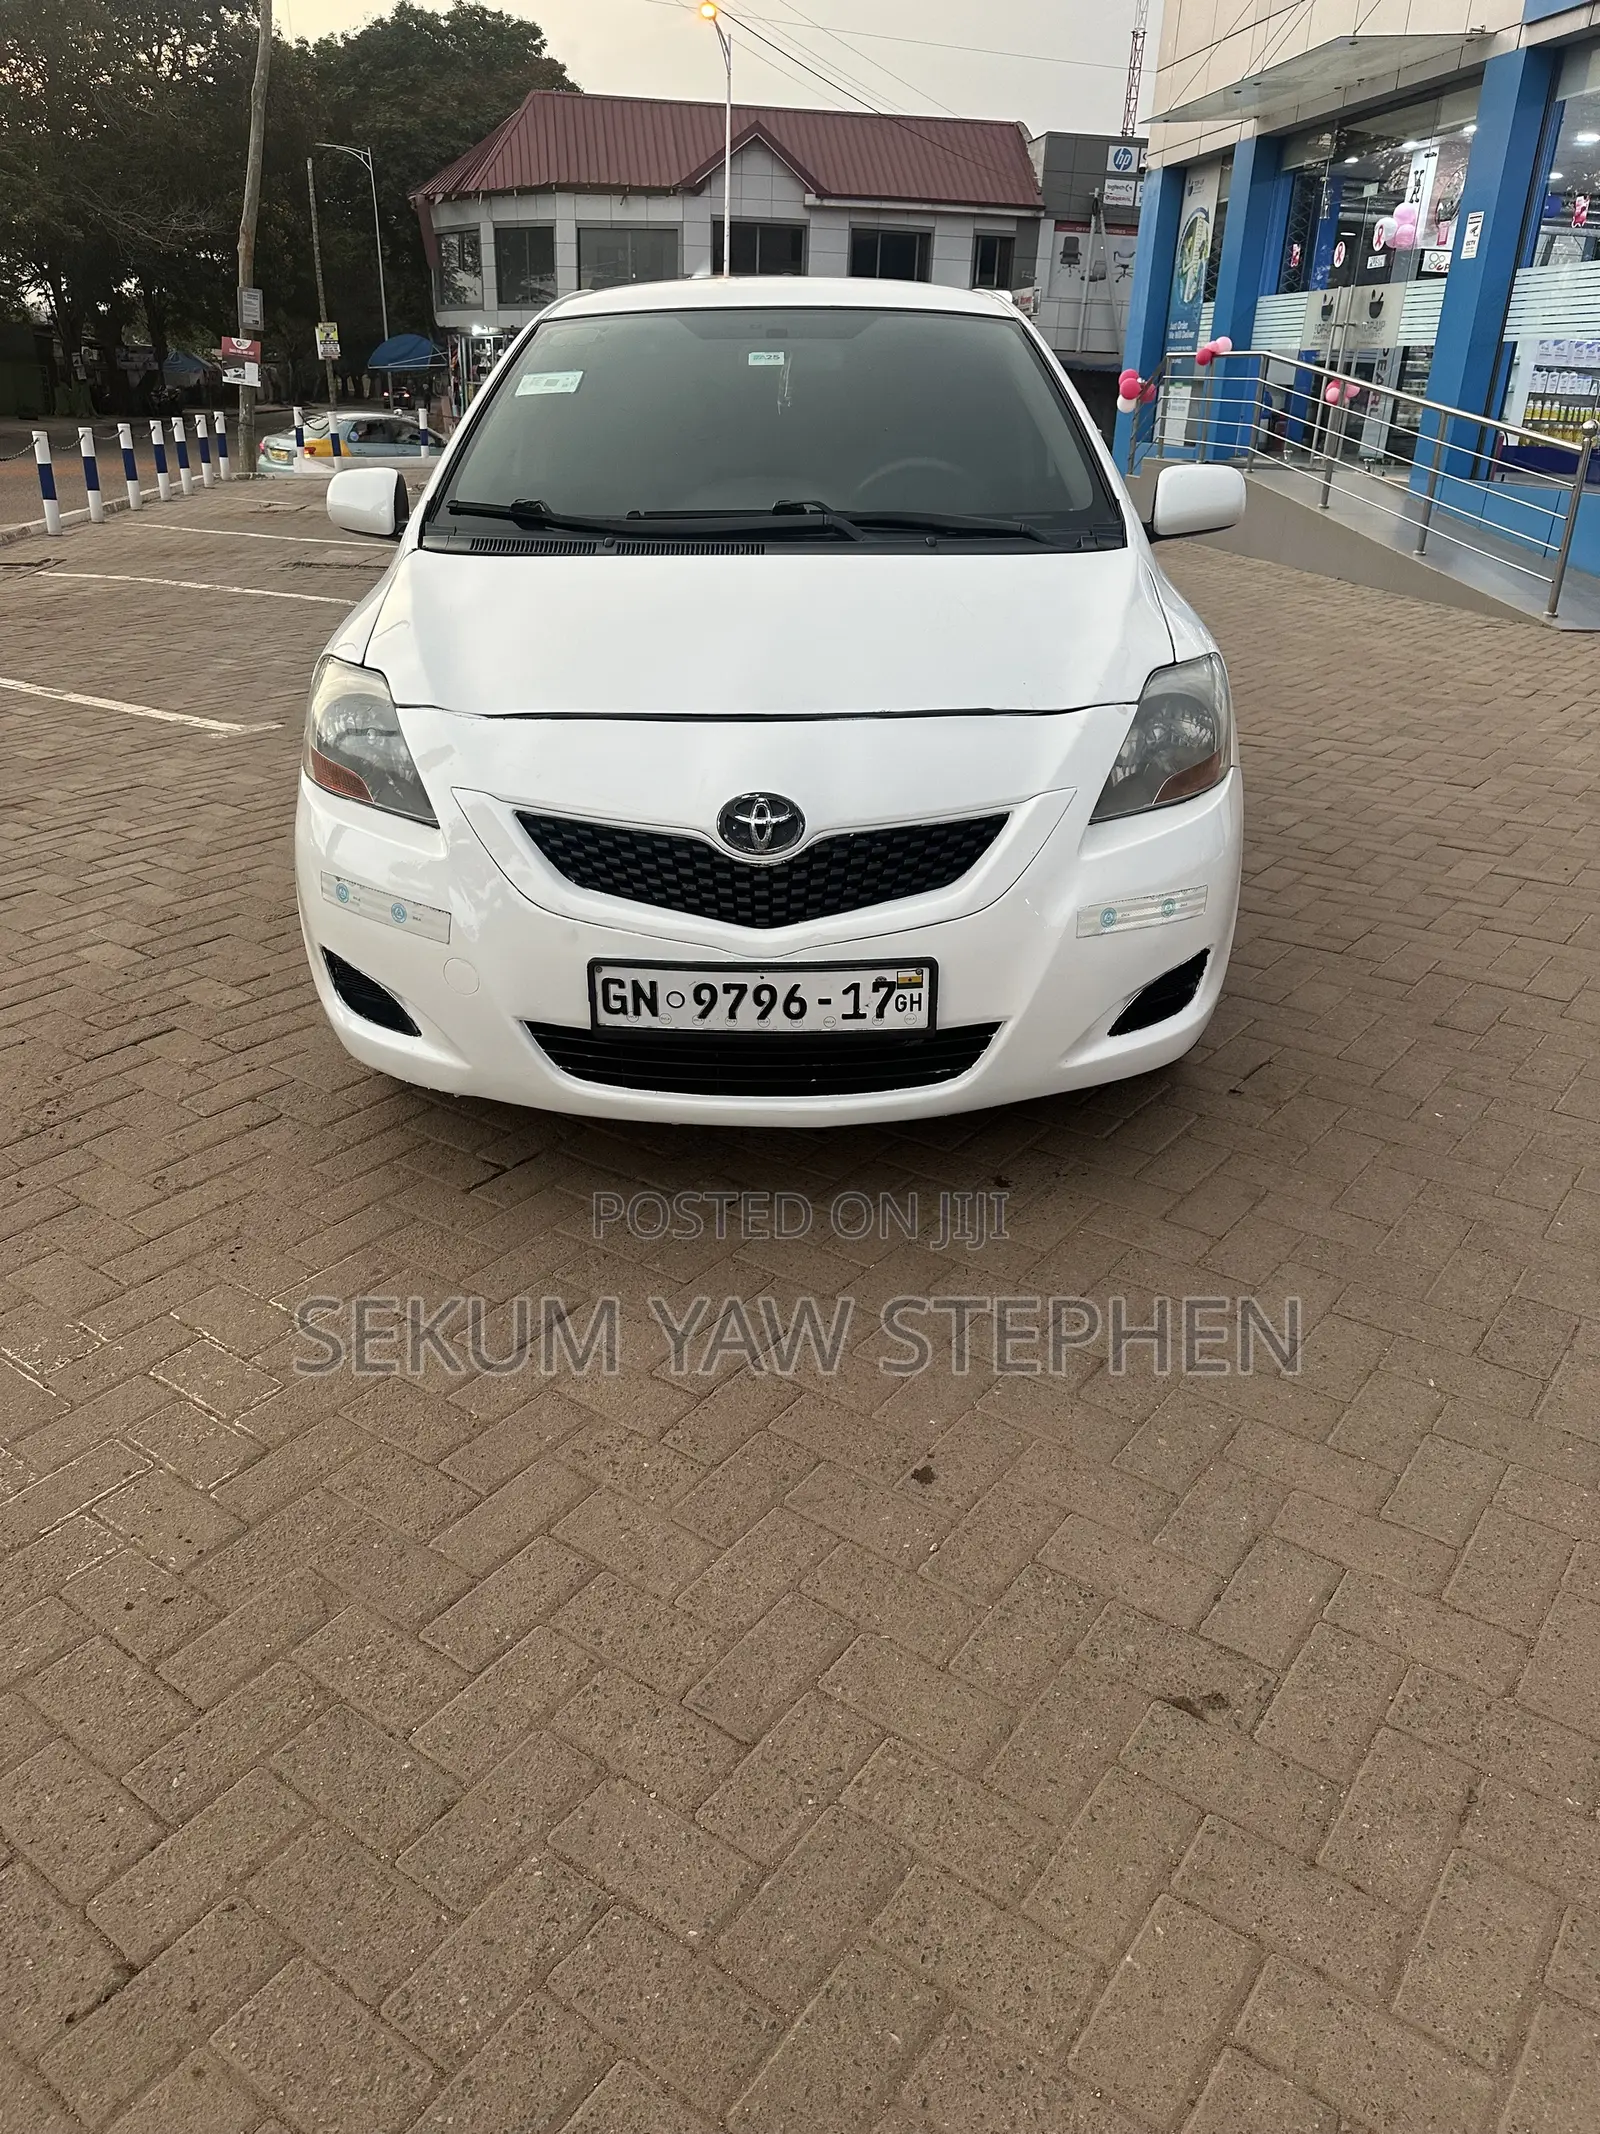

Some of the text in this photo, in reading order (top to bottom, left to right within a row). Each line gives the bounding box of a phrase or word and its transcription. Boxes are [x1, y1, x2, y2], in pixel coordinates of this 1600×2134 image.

[1115, 148, 1131, 170] hp
[601, 977, 660, 1017] GN
[895, 993, 922, 1013] GH
